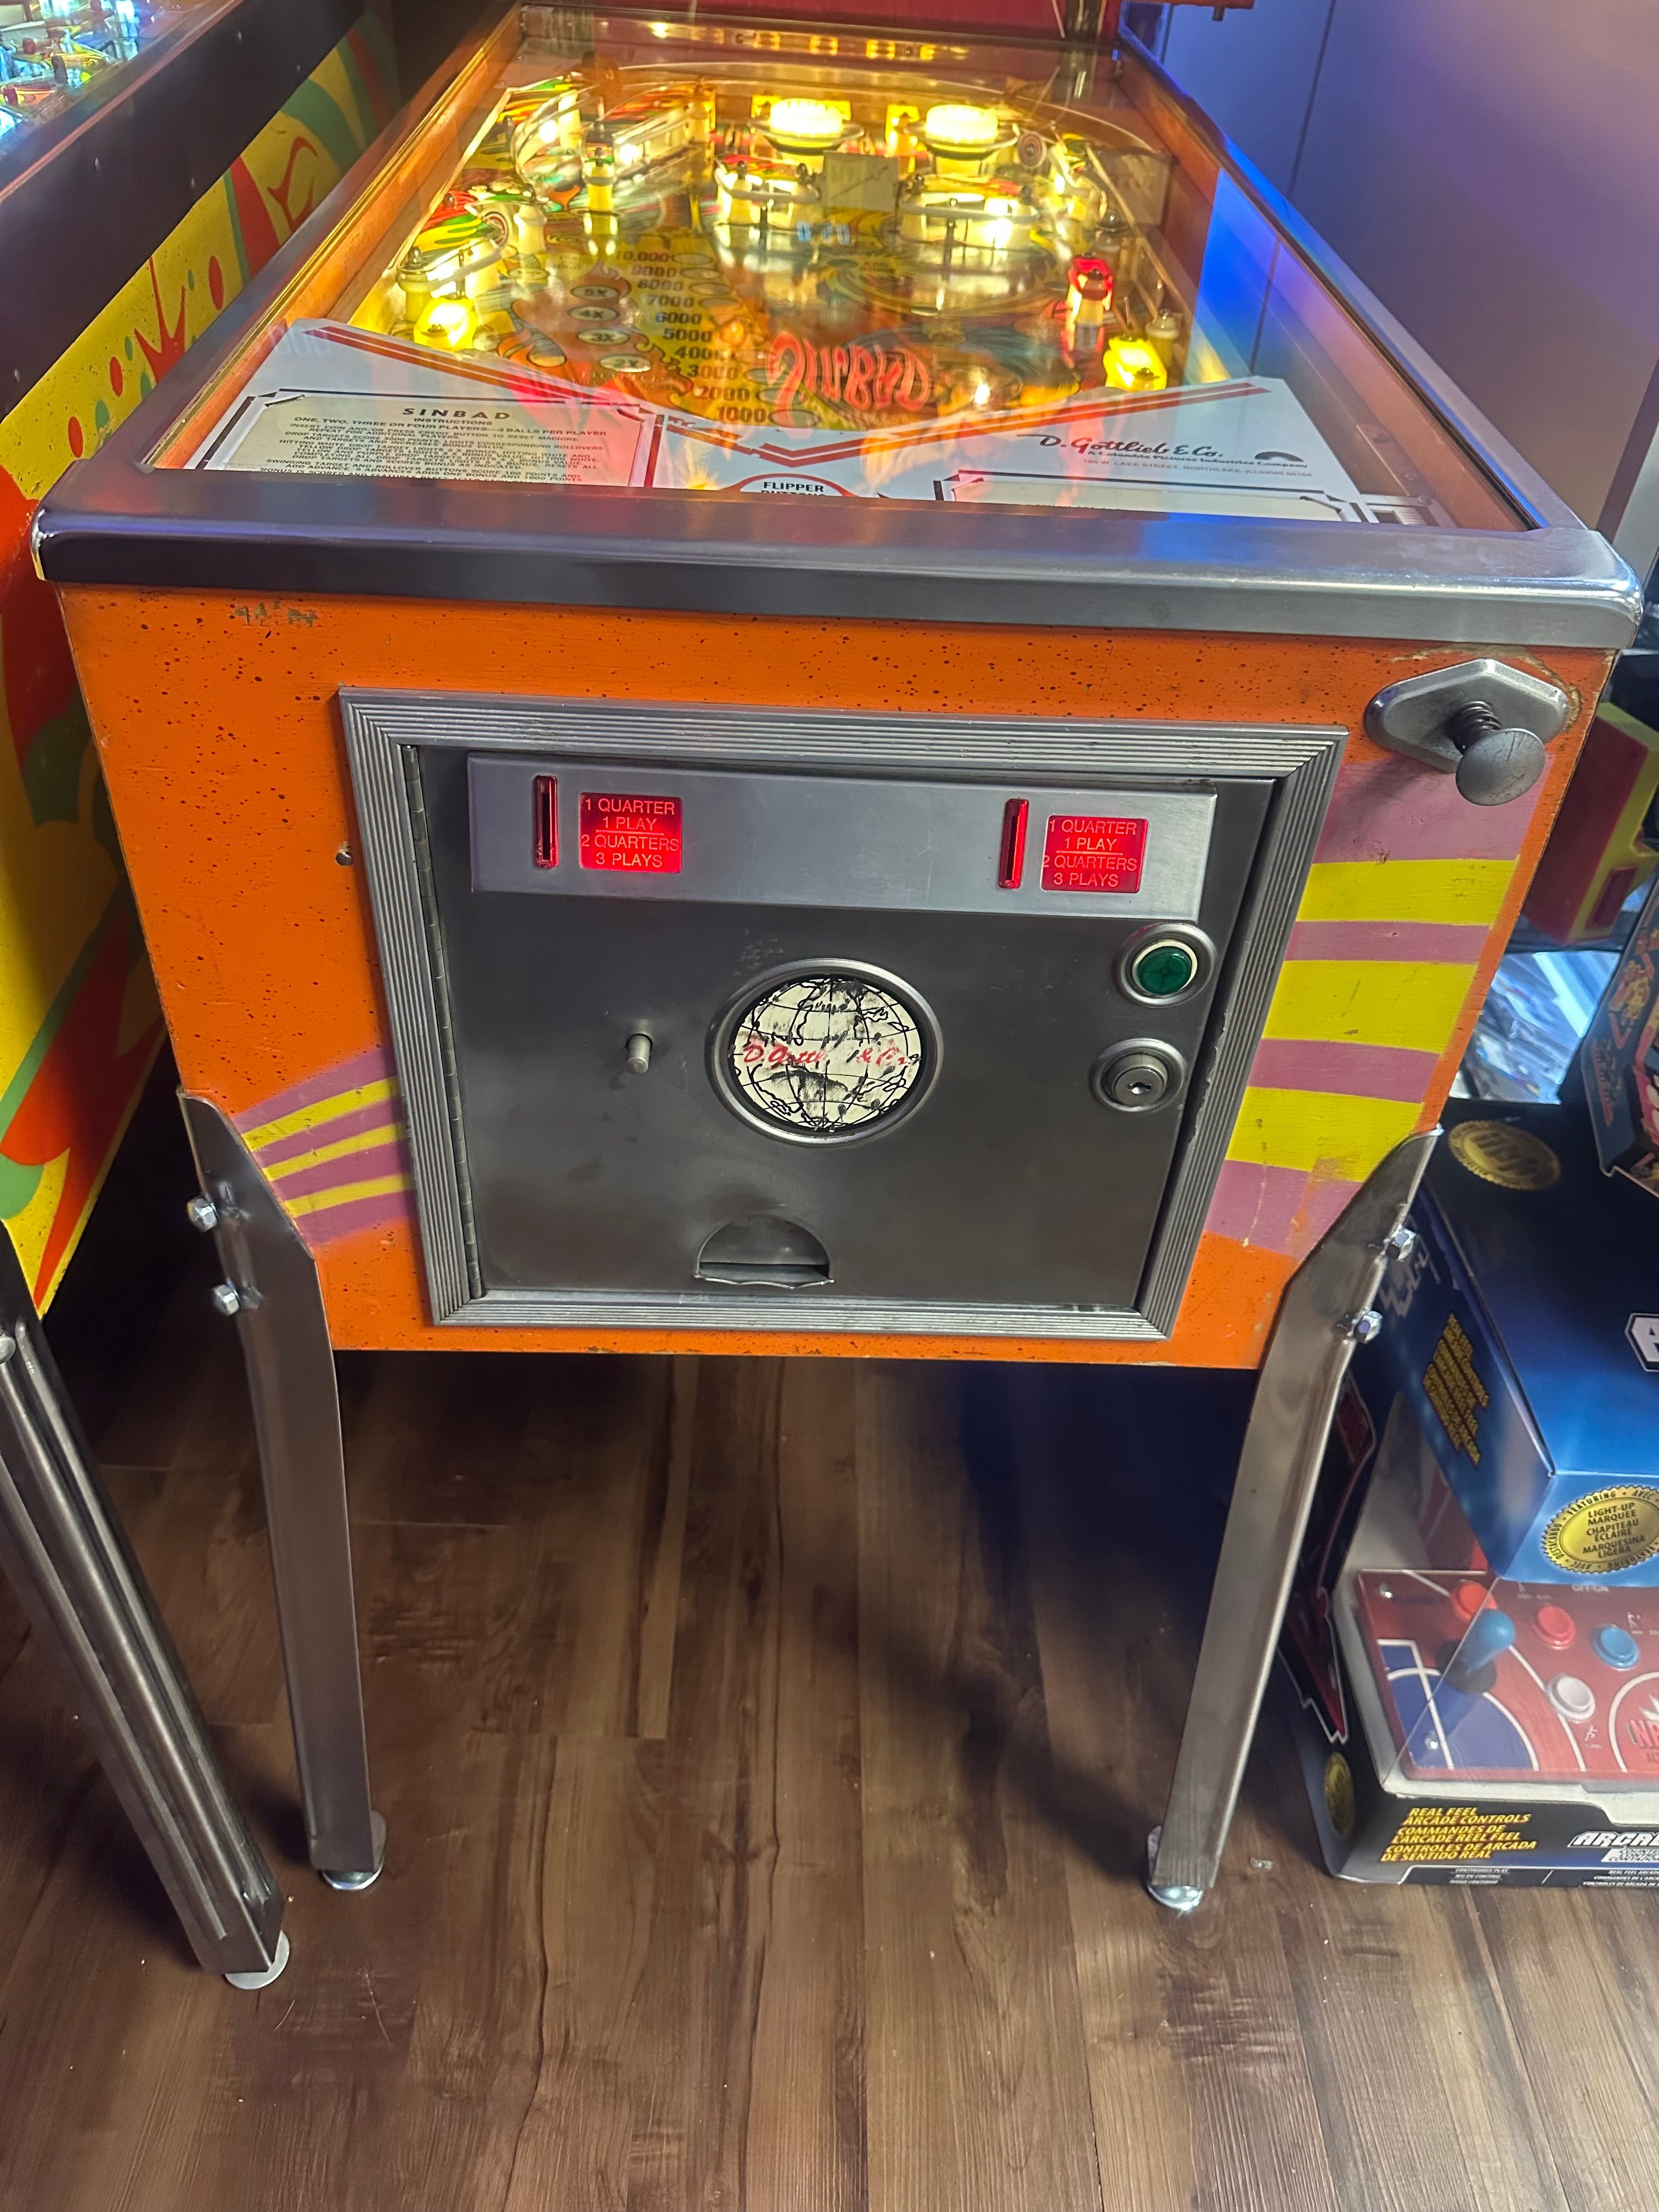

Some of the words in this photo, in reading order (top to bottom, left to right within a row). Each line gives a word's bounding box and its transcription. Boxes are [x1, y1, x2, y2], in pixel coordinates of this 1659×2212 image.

[655, 311, 702, 324] 6000
[663, 328, 712, 341] 5000
[687, 364, 739, 380] 3000
[695, 386, 751, 402] 2000
[402, 408, 510, 420] SINBAD
[414, 417, 493, 426] INSTRUCTIONS
[716, 407, 768, 422] 1000
[478, 441, 551, 449] CORRESPONDING
[1070, 438, 1170, 454] Gottlieb
[1192, 446, 1223, 457] Co.
[764, 482, 824, 493] FLIPPER
[585, 799, 591, 811] 1
[598, 798, 675, 815] QUARTER
[603, 816, 608, 828] 1
[616, 816, 657, 831] PLAY
[1049, 819, 1056, 833] 1
[1062, 820, 1137, 836] QUARTER
[581, 834, 590, 847] 2
[594, 834, 679, 851] QUARTERS
[1064, 837, 1070, 849] 1
[1076, 837, 1118, 851] PLAY
[596, 852, 606, 865] 3
[612, 853, 663, 868] PLAYS
[1043, 855, 1050, 867] 2
[1054, 856, 1137, 871] QUARTERS
[1054, 872, 1063, 885] 3
[1069, 873, 1119, 888] PLAYS
[1631, 1489, 1655, 1500] AVEC
[1566, 1490, 1616, 1515] FEATURING
[1588, 1502, 1635, 1517] LIGHT-UP
[1587, 1509, 1637, 1526] MARQUEE
[1585, 1518, 1639, 1536] CHAPITEAU
[1547, 1523, 1565, 1560] DESTACANDO
[1582, 1534, 1646, 1554] MARQUESINA
[1598, 1545, 1632, 1558] LIGERA
[1408, 1807, 1444, 1816] REAL
[1446, 1807, 1478, 1816] FEEL
[1401, 1816, 1459, 1826] ARCADE
[1459, 1814, 1532, 1824] CONTROLS
[1397, 1825, 1485, 1836] COMMANDES
[1486, 1824, 1506, 1833] DE
[1392, 1833, 1454, 1844] L'ARCADE
[1455, 1833, 1488, 1842] REEL
[1490, 1832, 1521, 1841] FEEL
[1385, 1843, 1460, 1854] CONTROLES
[1464, 1842, 1482, 1851] DE
[1483, 1841, 1537, 1850] ARCADA
[1381, 1853, 1398, 1862] DE
[1401, 1852, 1459, 1861] SENTIDO
[1459, 1850, 1492, 1859] REAL
